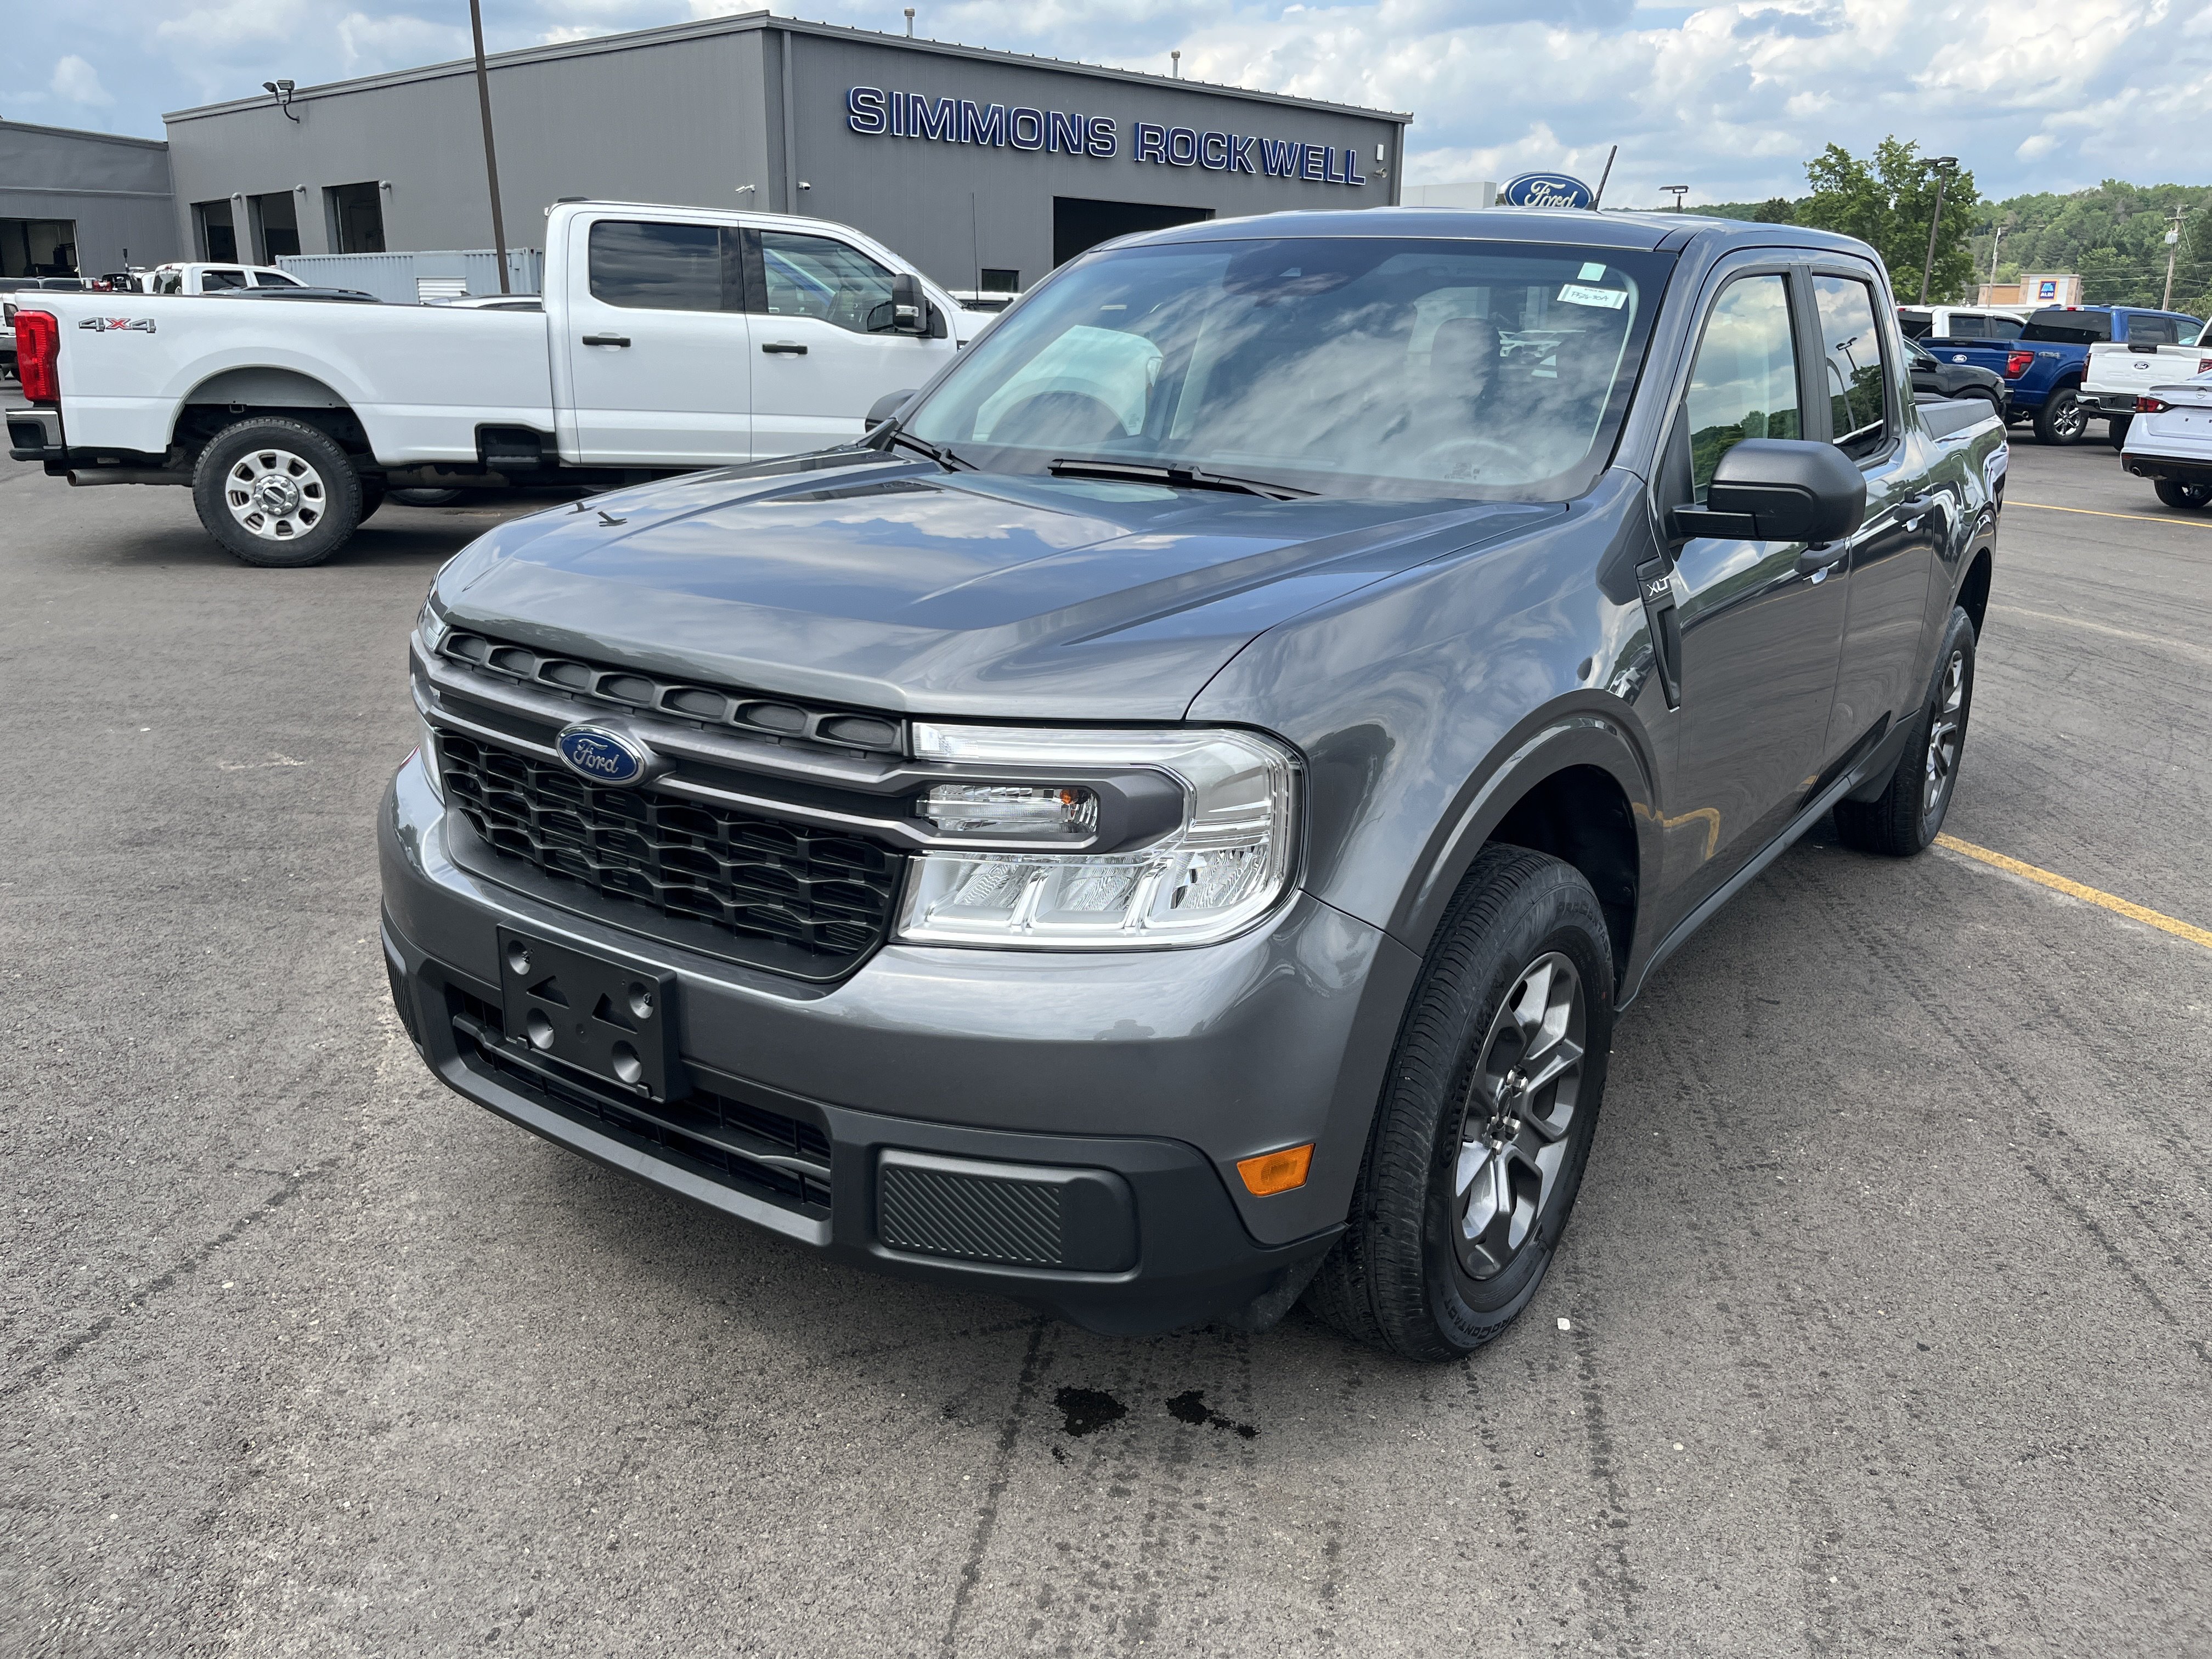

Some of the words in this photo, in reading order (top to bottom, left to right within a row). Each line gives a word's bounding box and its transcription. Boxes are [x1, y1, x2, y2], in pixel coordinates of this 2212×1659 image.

[847, 86, 1118, 157] SIMMONS
[1524, 180, 1578, 208] Ford
[1646, 575, 1669, 596] XLT
[573, 738, 619, 774] Ford
